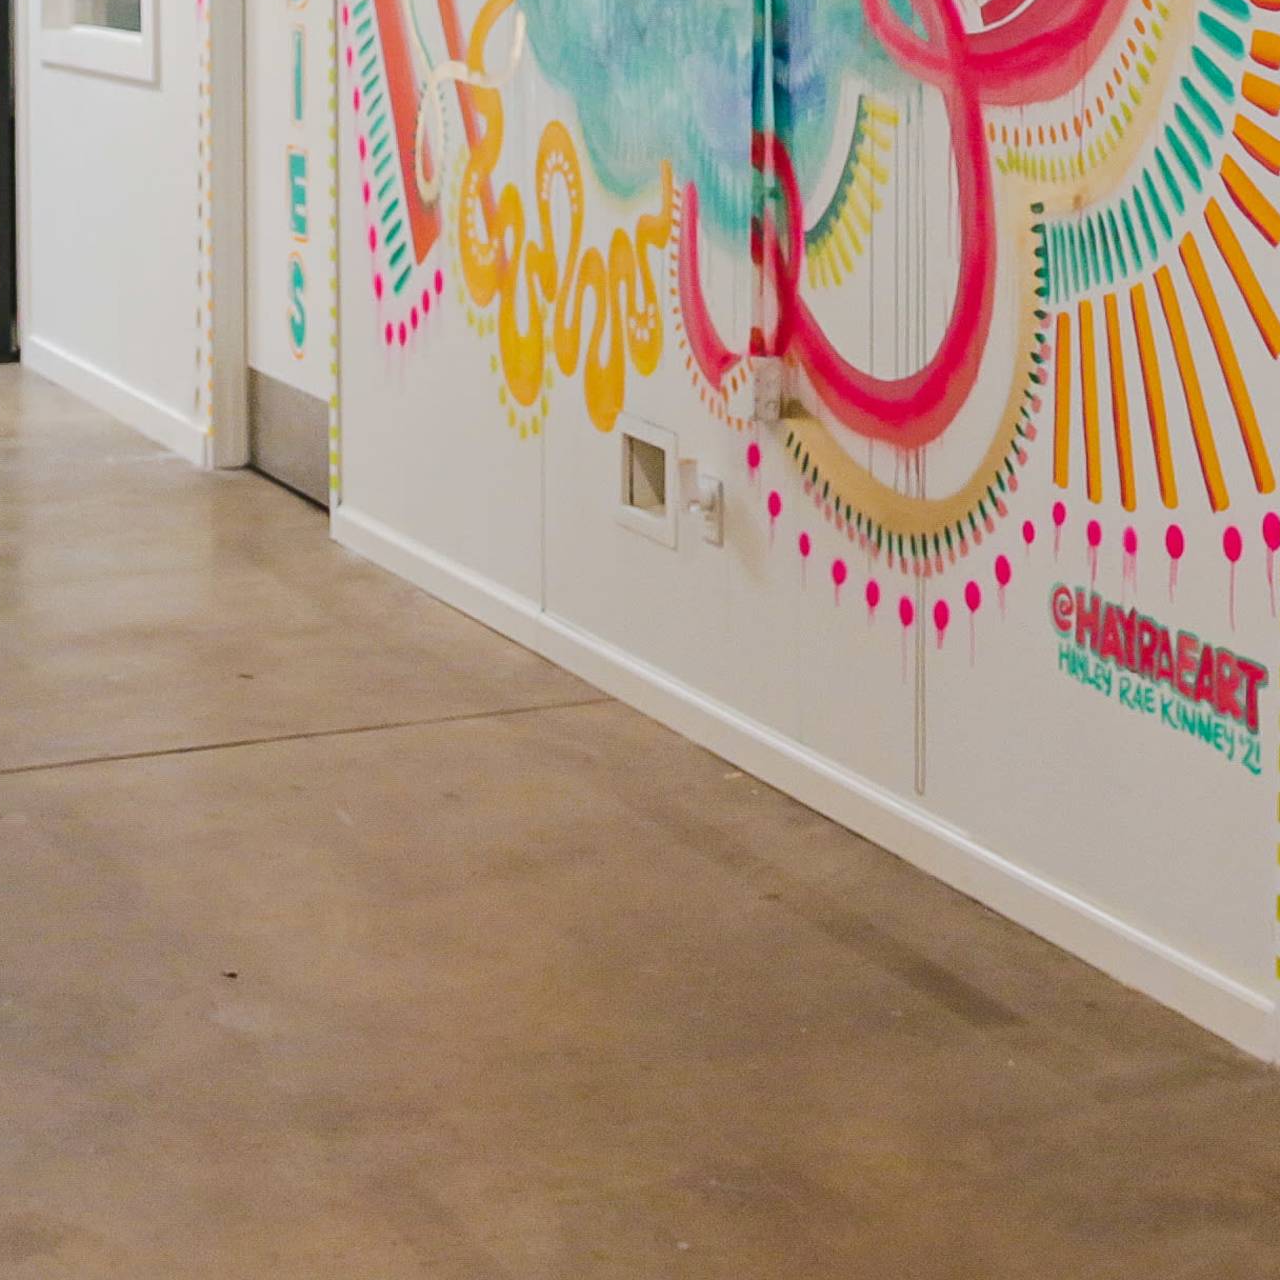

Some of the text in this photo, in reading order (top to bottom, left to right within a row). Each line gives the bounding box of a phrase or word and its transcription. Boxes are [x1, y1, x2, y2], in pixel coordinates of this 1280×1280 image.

[1051, 582, 1269, 735] @HAYRAEART
[1119, 676, 1156, 715] RAE
[1160, 694, 1236, 762] KINNEY
